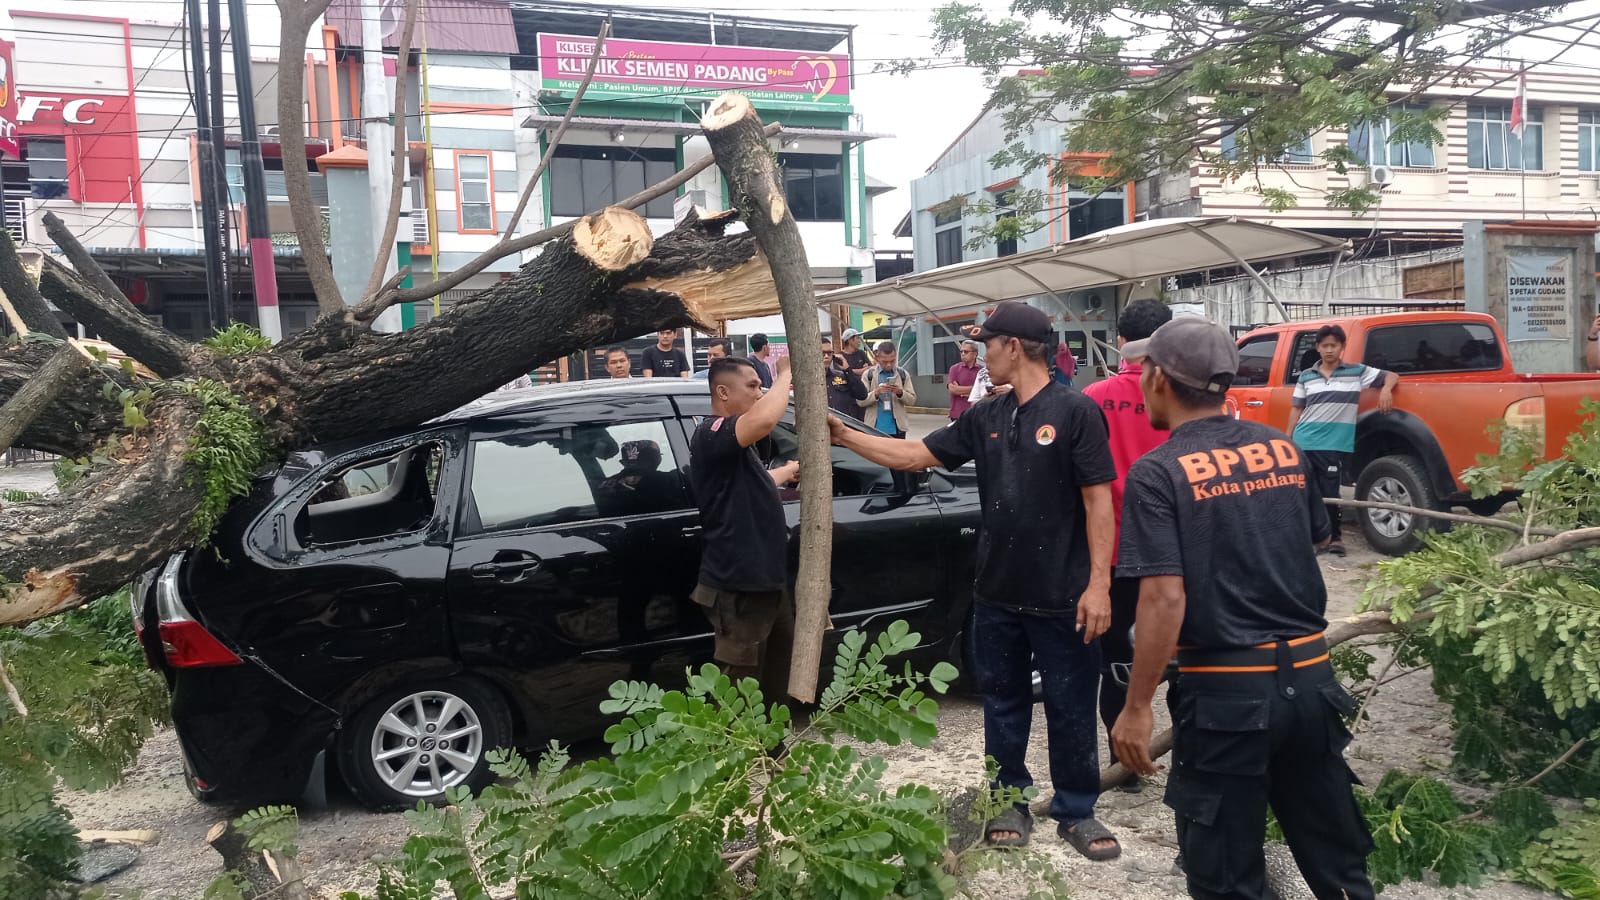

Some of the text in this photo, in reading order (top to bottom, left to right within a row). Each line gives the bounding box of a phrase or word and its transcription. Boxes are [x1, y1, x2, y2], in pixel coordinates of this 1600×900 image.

[624, 60, 688, 78] SEMEN
[694, 64, 767, 82] PADANG
[767, 68, 778, 77] By
[559, 81, 597, 90] Melani
[604, 83, 631, 93] Pasien
[16, 94, 105, 125] FC
[1510, 277, 1565, 286] DISEWAKAN
[1103, 399, 1145, 415] BPB
[1178, 439, 1300, 483] BPBD
[1191, 472, 1306, 502] Kota padang
